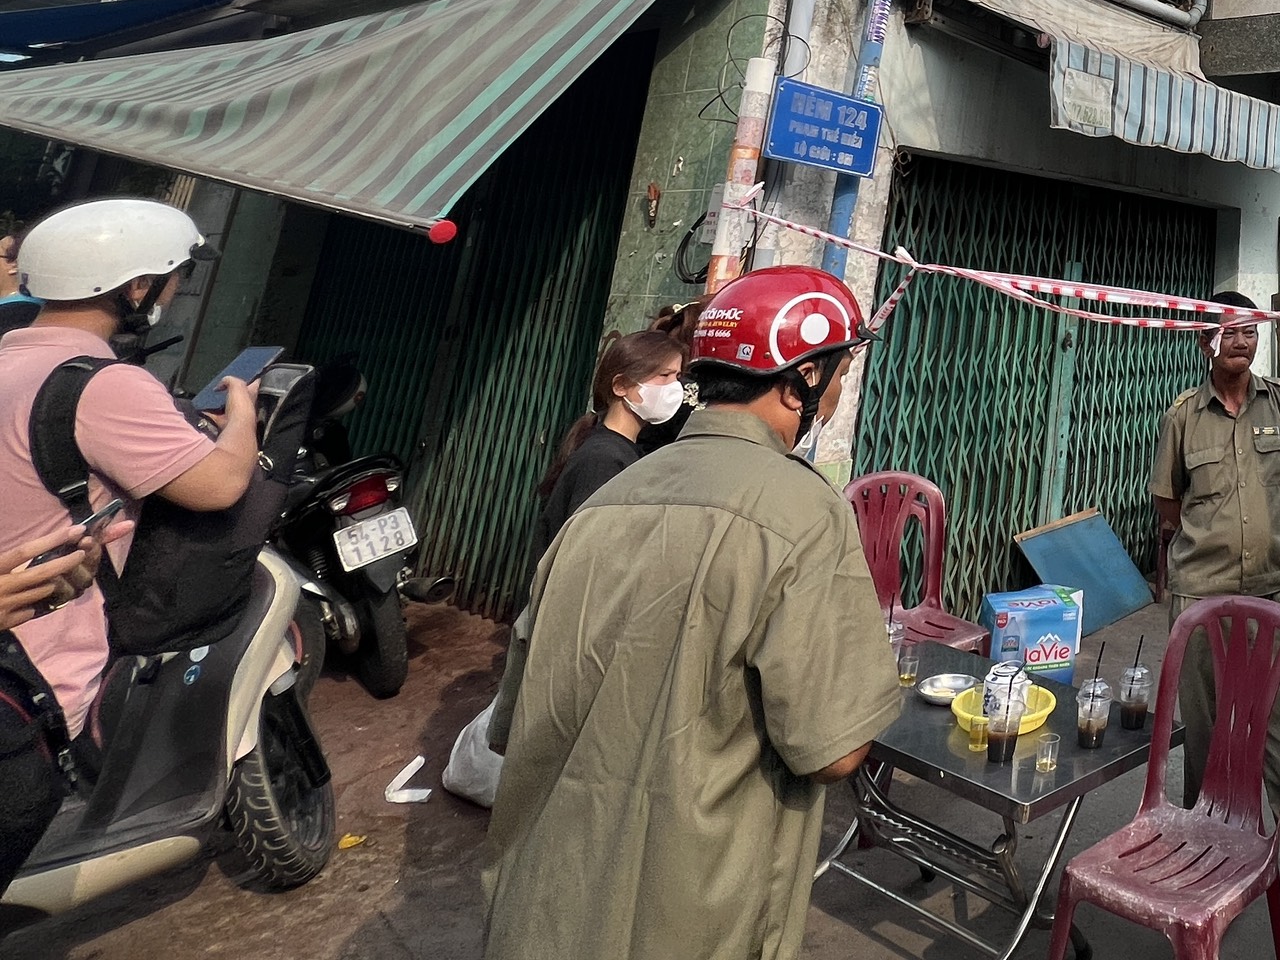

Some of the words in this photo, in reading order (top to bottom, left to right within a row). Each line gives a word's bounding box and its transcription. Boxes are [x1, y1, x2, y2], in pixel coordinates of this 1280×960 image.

[791, 91, 833, 121] HẺM
[837, 105, 868, 130] 124
[352, 530, 405, 563] 1128
